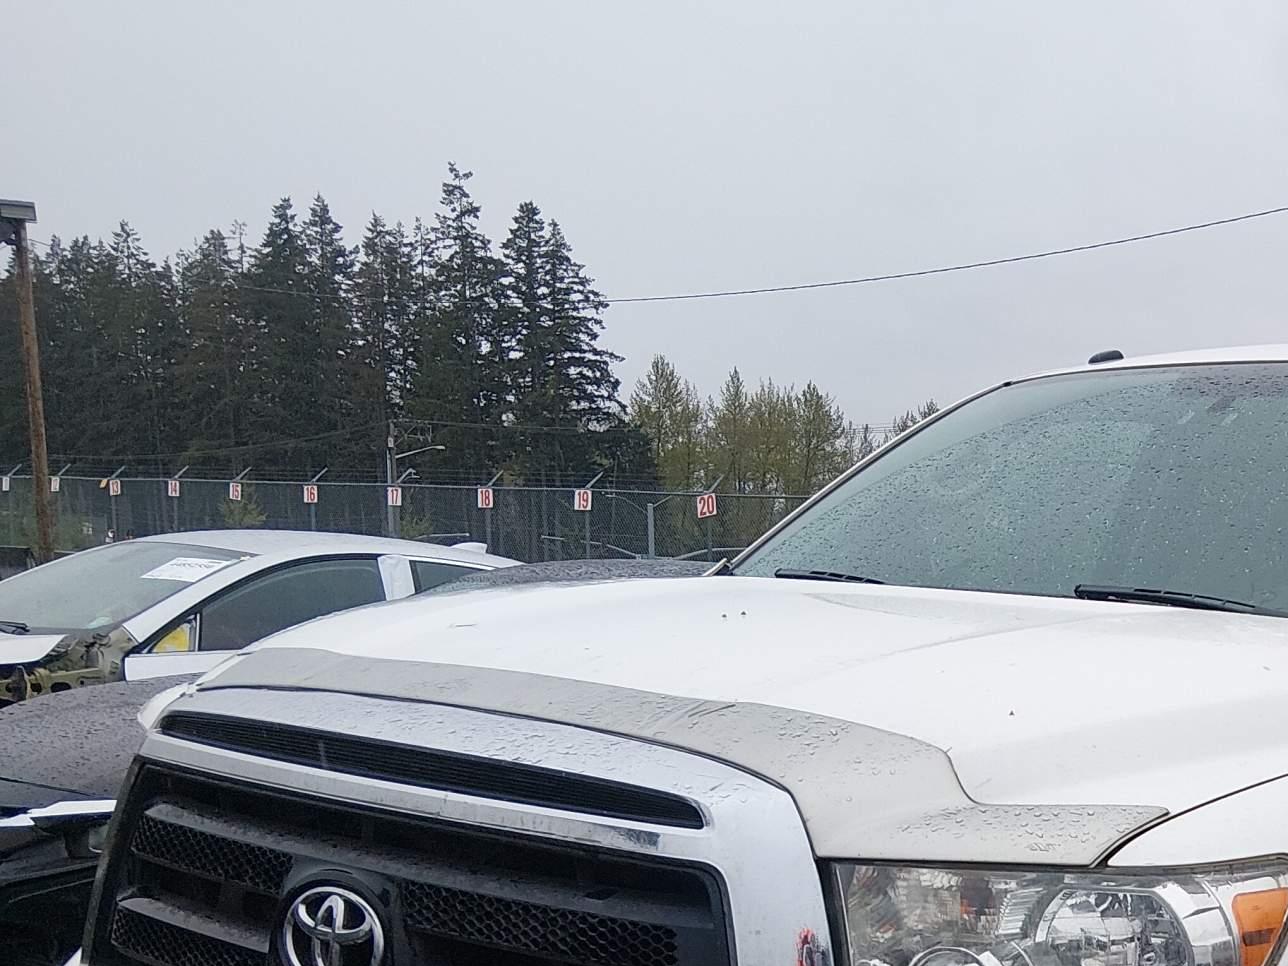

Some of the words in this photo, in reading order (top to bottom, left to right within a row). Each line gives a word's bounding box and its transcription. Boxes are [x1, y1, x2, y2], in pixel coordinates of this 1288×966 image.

[111, 480, 119, 494] 13
[170, 482, 178, 495] 14
[231, 483, 240, 499] 15
[306, 486, 316, 502] 16
[390, 488, 399, 505] 17
[480, 489, 491, 507] 18
[577, 491, 589, 509] 19
[698, 495, 714, 515] 20
